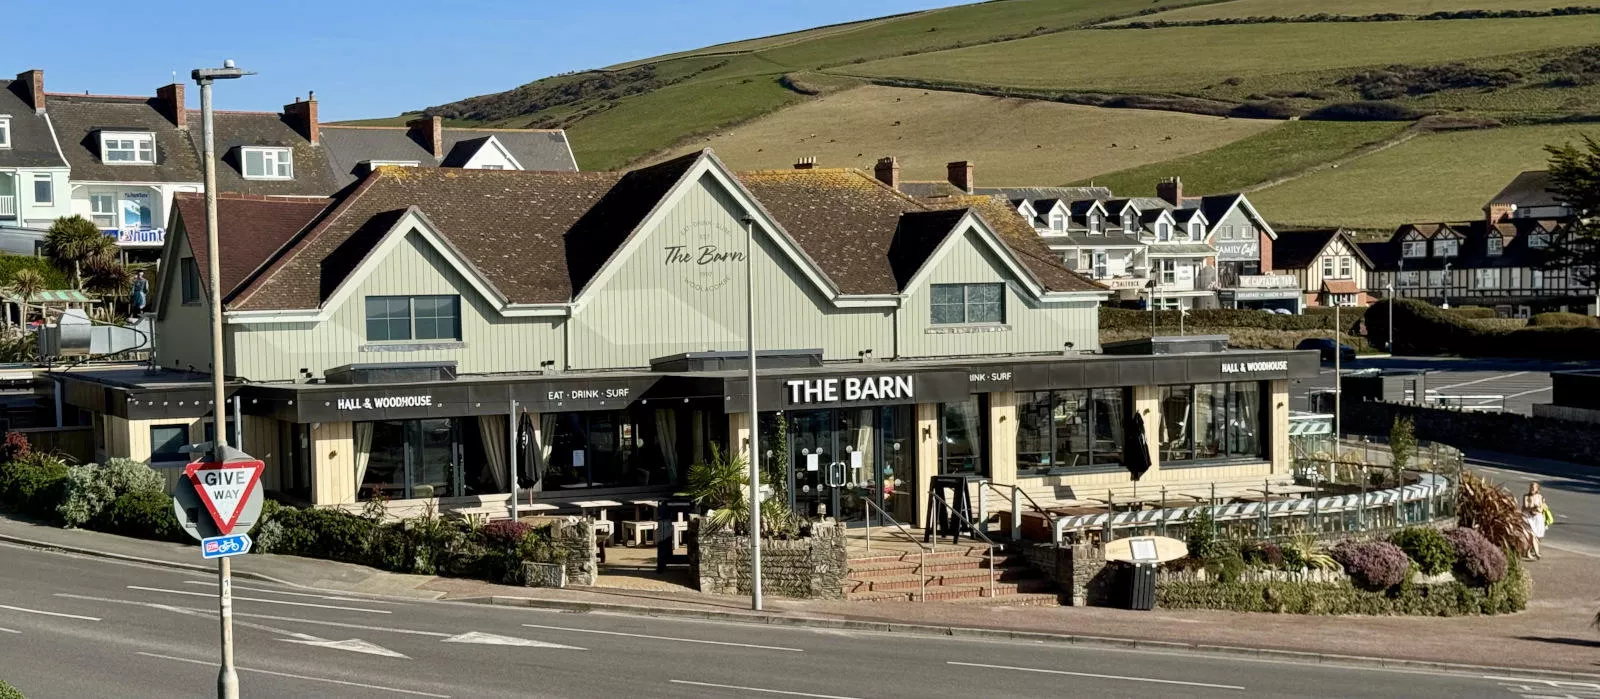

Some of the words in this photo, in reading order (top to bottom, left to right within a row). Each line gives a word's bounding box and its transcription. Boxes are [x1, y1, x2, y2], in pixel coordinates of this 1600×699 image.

[664, 245, 693, 266] The
[696, 245, 747, 265] Barn
[1215, 245, 1241, 254] FAMILY
[1221, 363, 1239, 373] HALL
[1240, 362, 1246, 373] &
[1247, 361, 1288, 371] WOODHOUSE
[991, 372, 1012, 381] SURF
[548, 391, 564, 400] EAT
[571, 390, 599, 399] DRINK
[606, 388, 629, 398] SURF
[787, 378, 838, 403] THE
[845, 375, 913, 400] BARN
[337, 398, 361, 410] HALL
[362, 398, 372, 409] &
[374, 395, 432, 408] WOODHOUSE
[205, 470, 246, 487] GIVE
[214, 489, 240, 500] WAY
